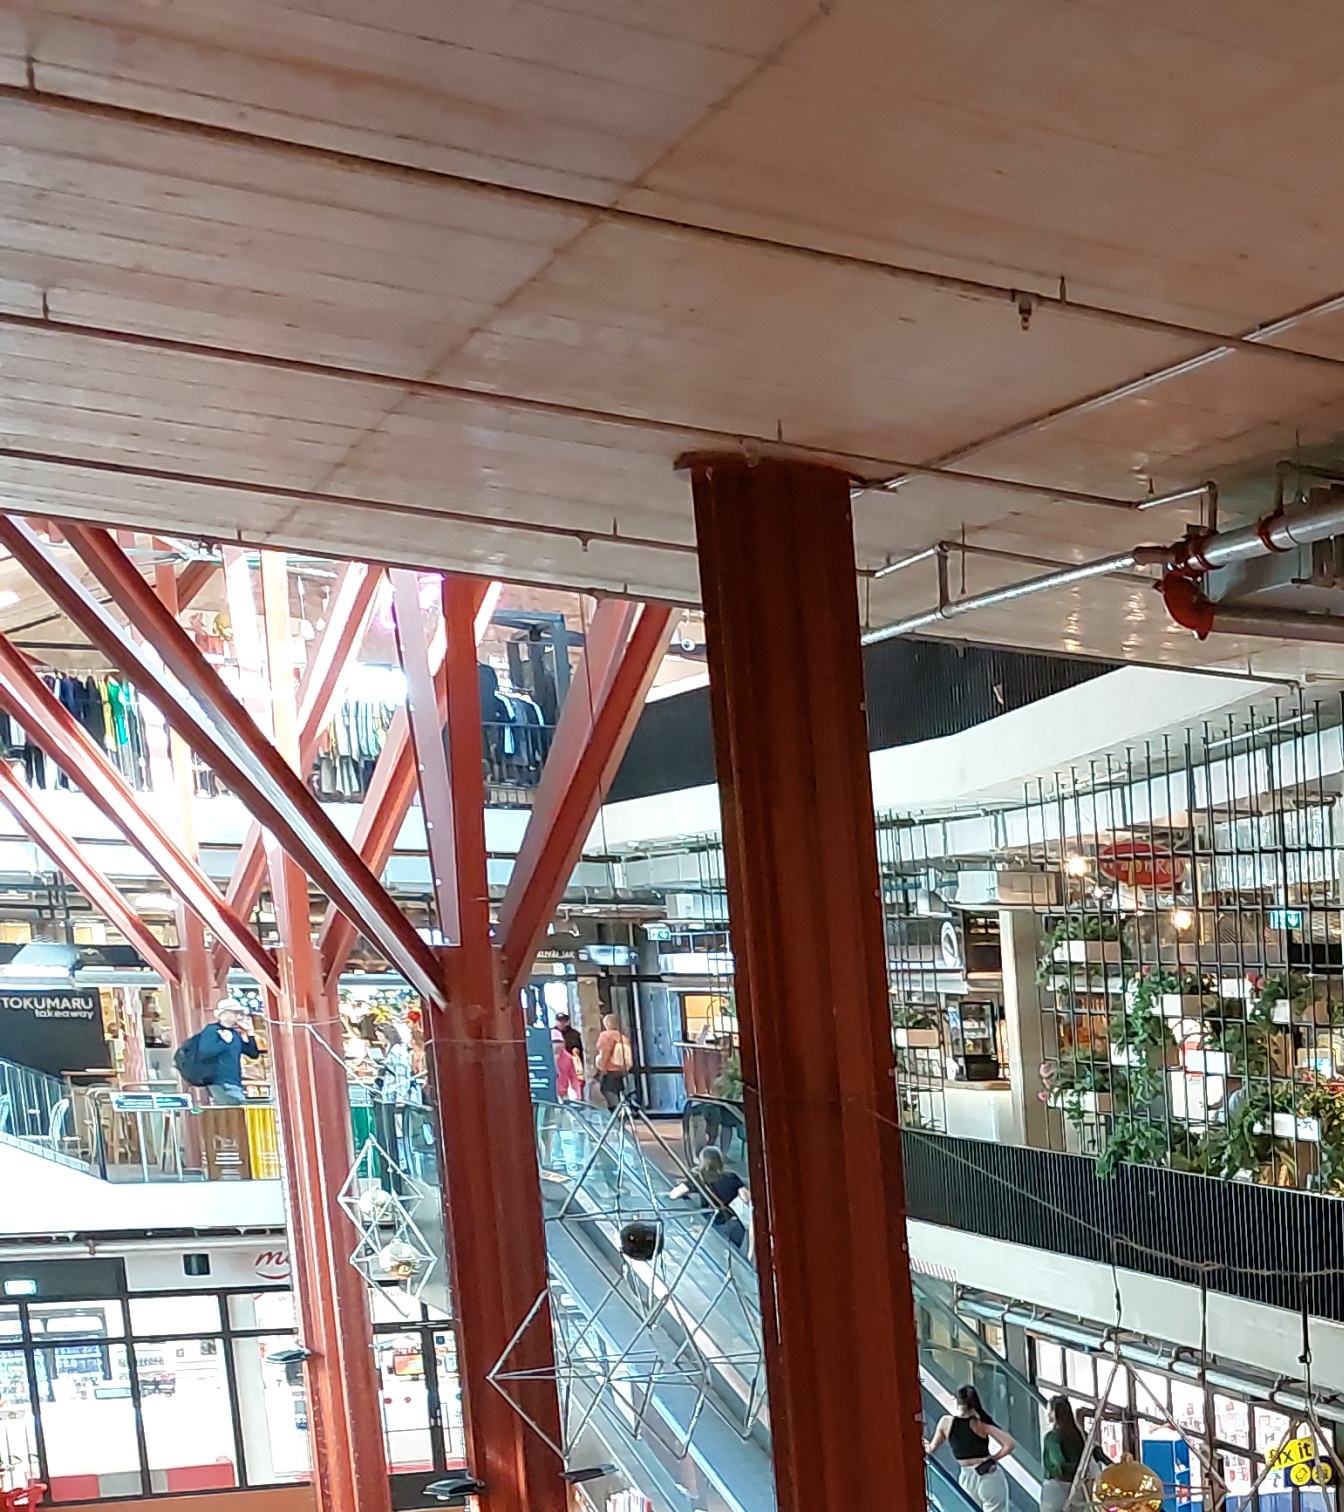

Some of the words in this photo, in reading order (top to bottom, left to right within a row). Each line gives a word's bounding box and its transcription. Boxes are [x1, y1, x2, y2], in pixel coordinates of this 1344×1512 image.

[2, 996, 93, 1010] TOKUMARU
[34, 1009, 94, 1020] takeaway
[1298, 1442, 1313, 1460] it
